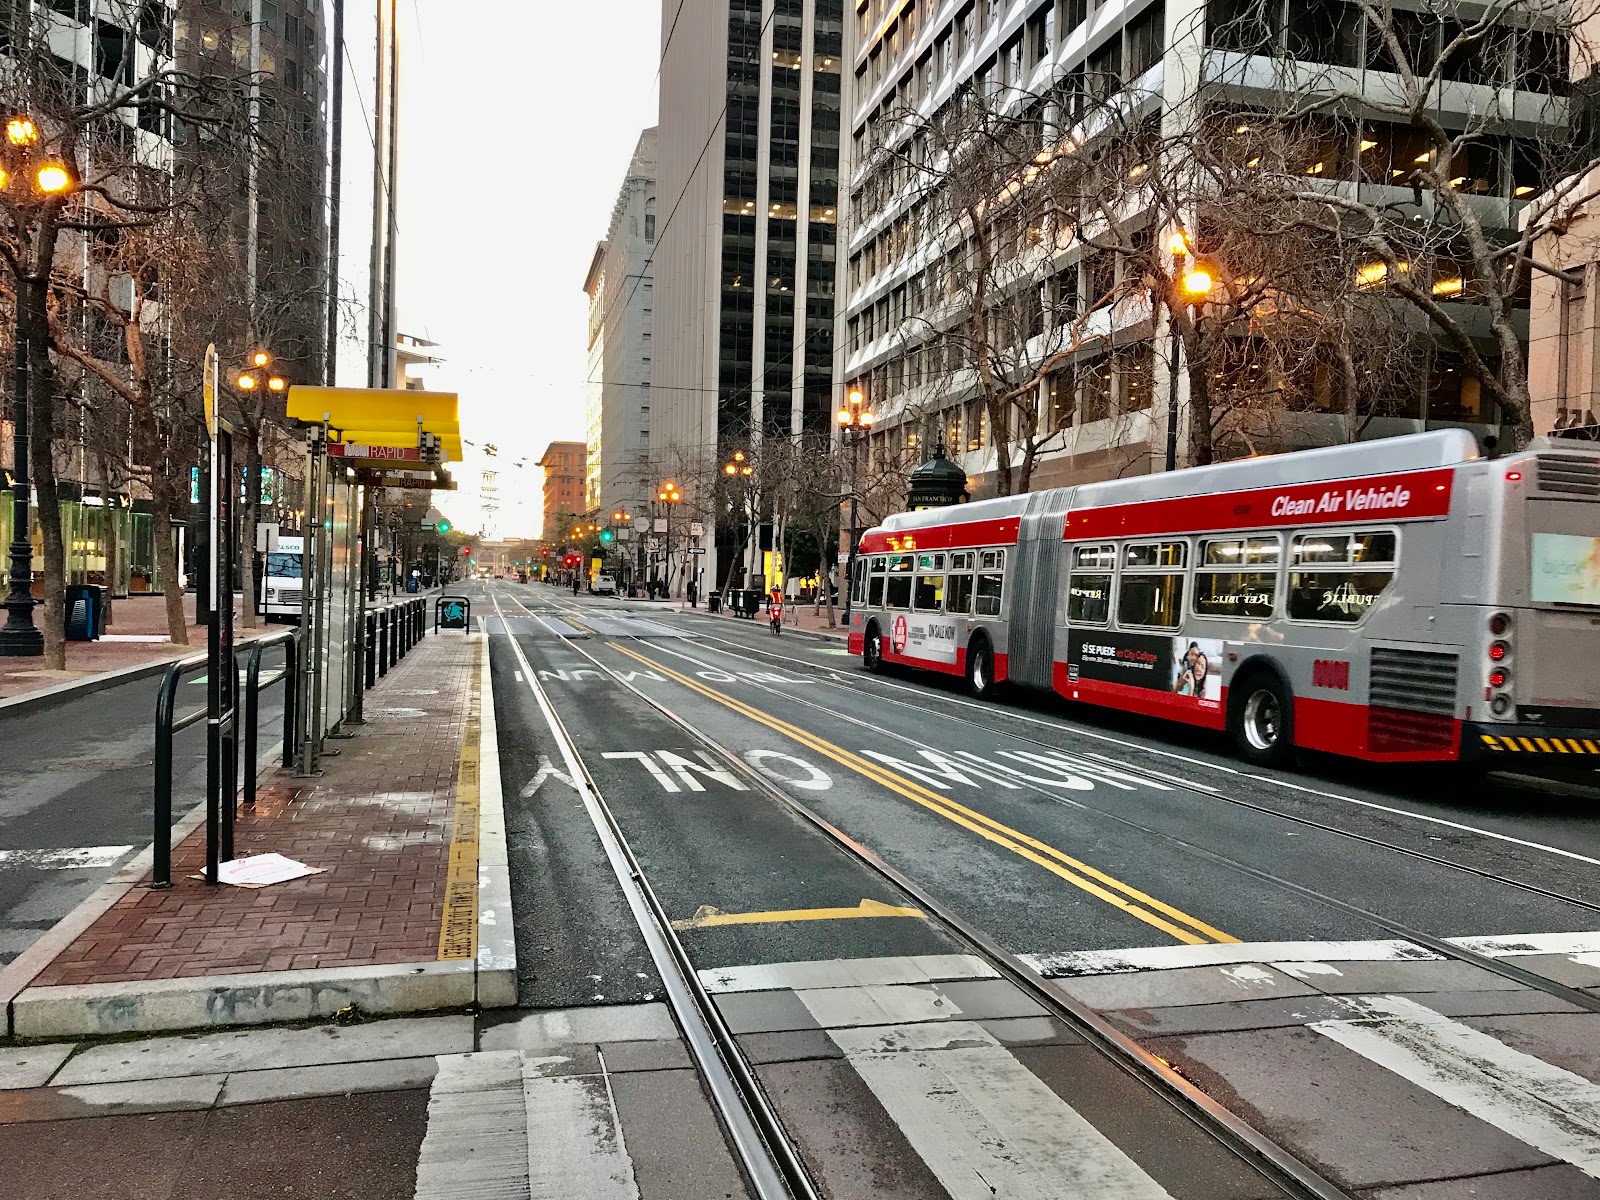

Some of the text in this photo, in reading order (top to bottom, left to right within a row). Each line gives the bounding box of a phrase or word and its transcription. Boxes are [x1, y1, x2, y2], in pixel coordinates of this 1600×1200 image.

[370, 446, 405, 459] RAPID
[400, 478, 426, 488] RAPID
[1271, 496, 1314, 516] Clean
[1316, 491, 1343, 514] Air
[1345, 485, 1411, 512] Vehicle
[929, 624, 935, 638] ON
[935, 625, 945, 639] SALE
[945, 626, 956, 640] NOW
[1088, 644, 1096, 655] SE
[1096, 645, 1116, 657] PUEDE
[519, 749, 834, 797] ONLY
[443, 937, 472, 958] STREET
